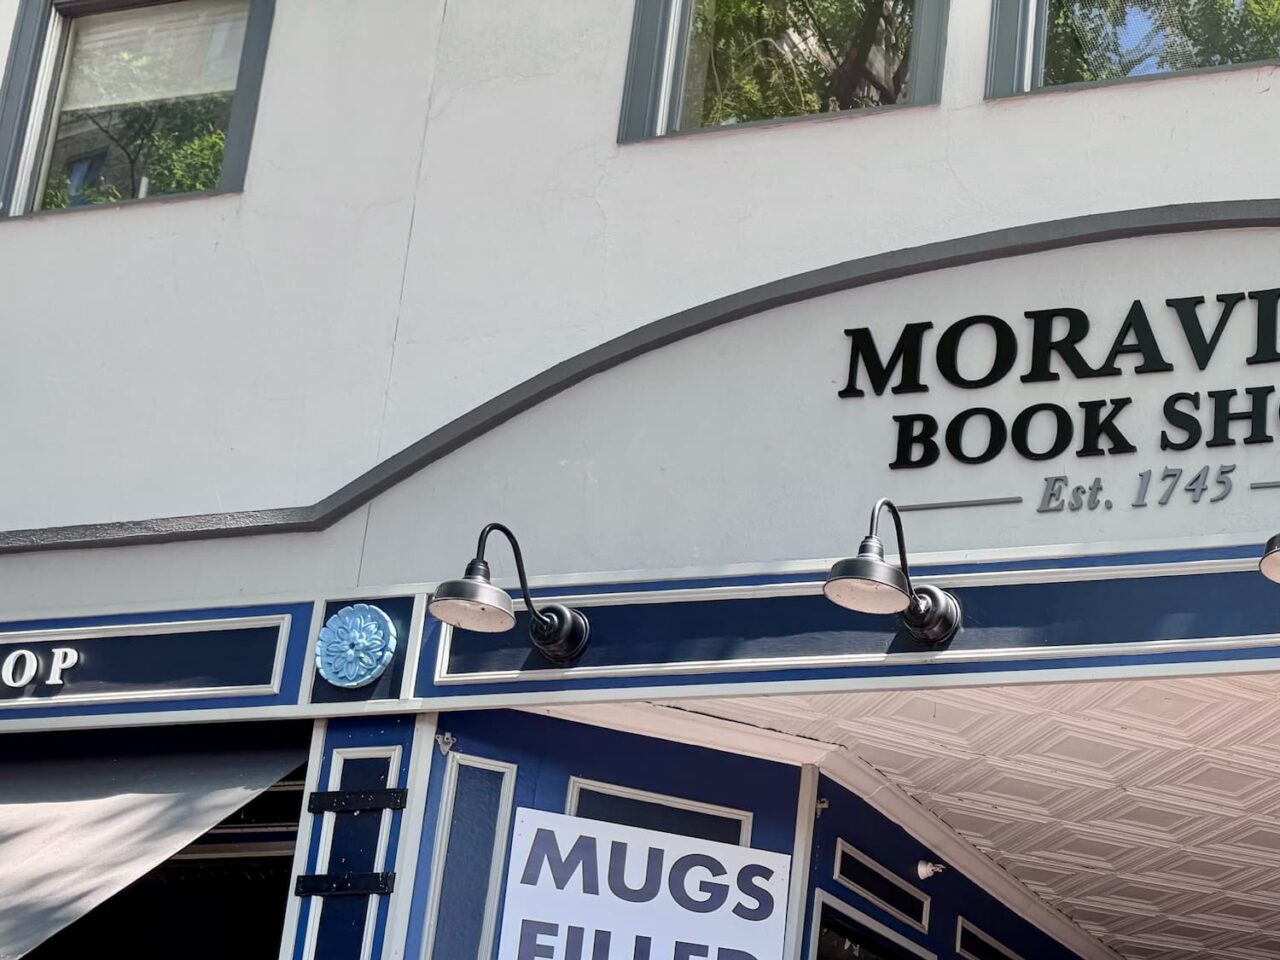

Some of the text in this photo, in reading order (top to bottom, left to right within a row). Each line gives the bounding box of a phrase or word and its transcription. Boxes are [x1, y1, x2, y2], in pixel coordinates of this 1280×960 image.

[889, 397, 1136, 470] BOOK
[1036, 463, 1237, 514] Est. 1745
[520, 828, 775, 922] MUGS
